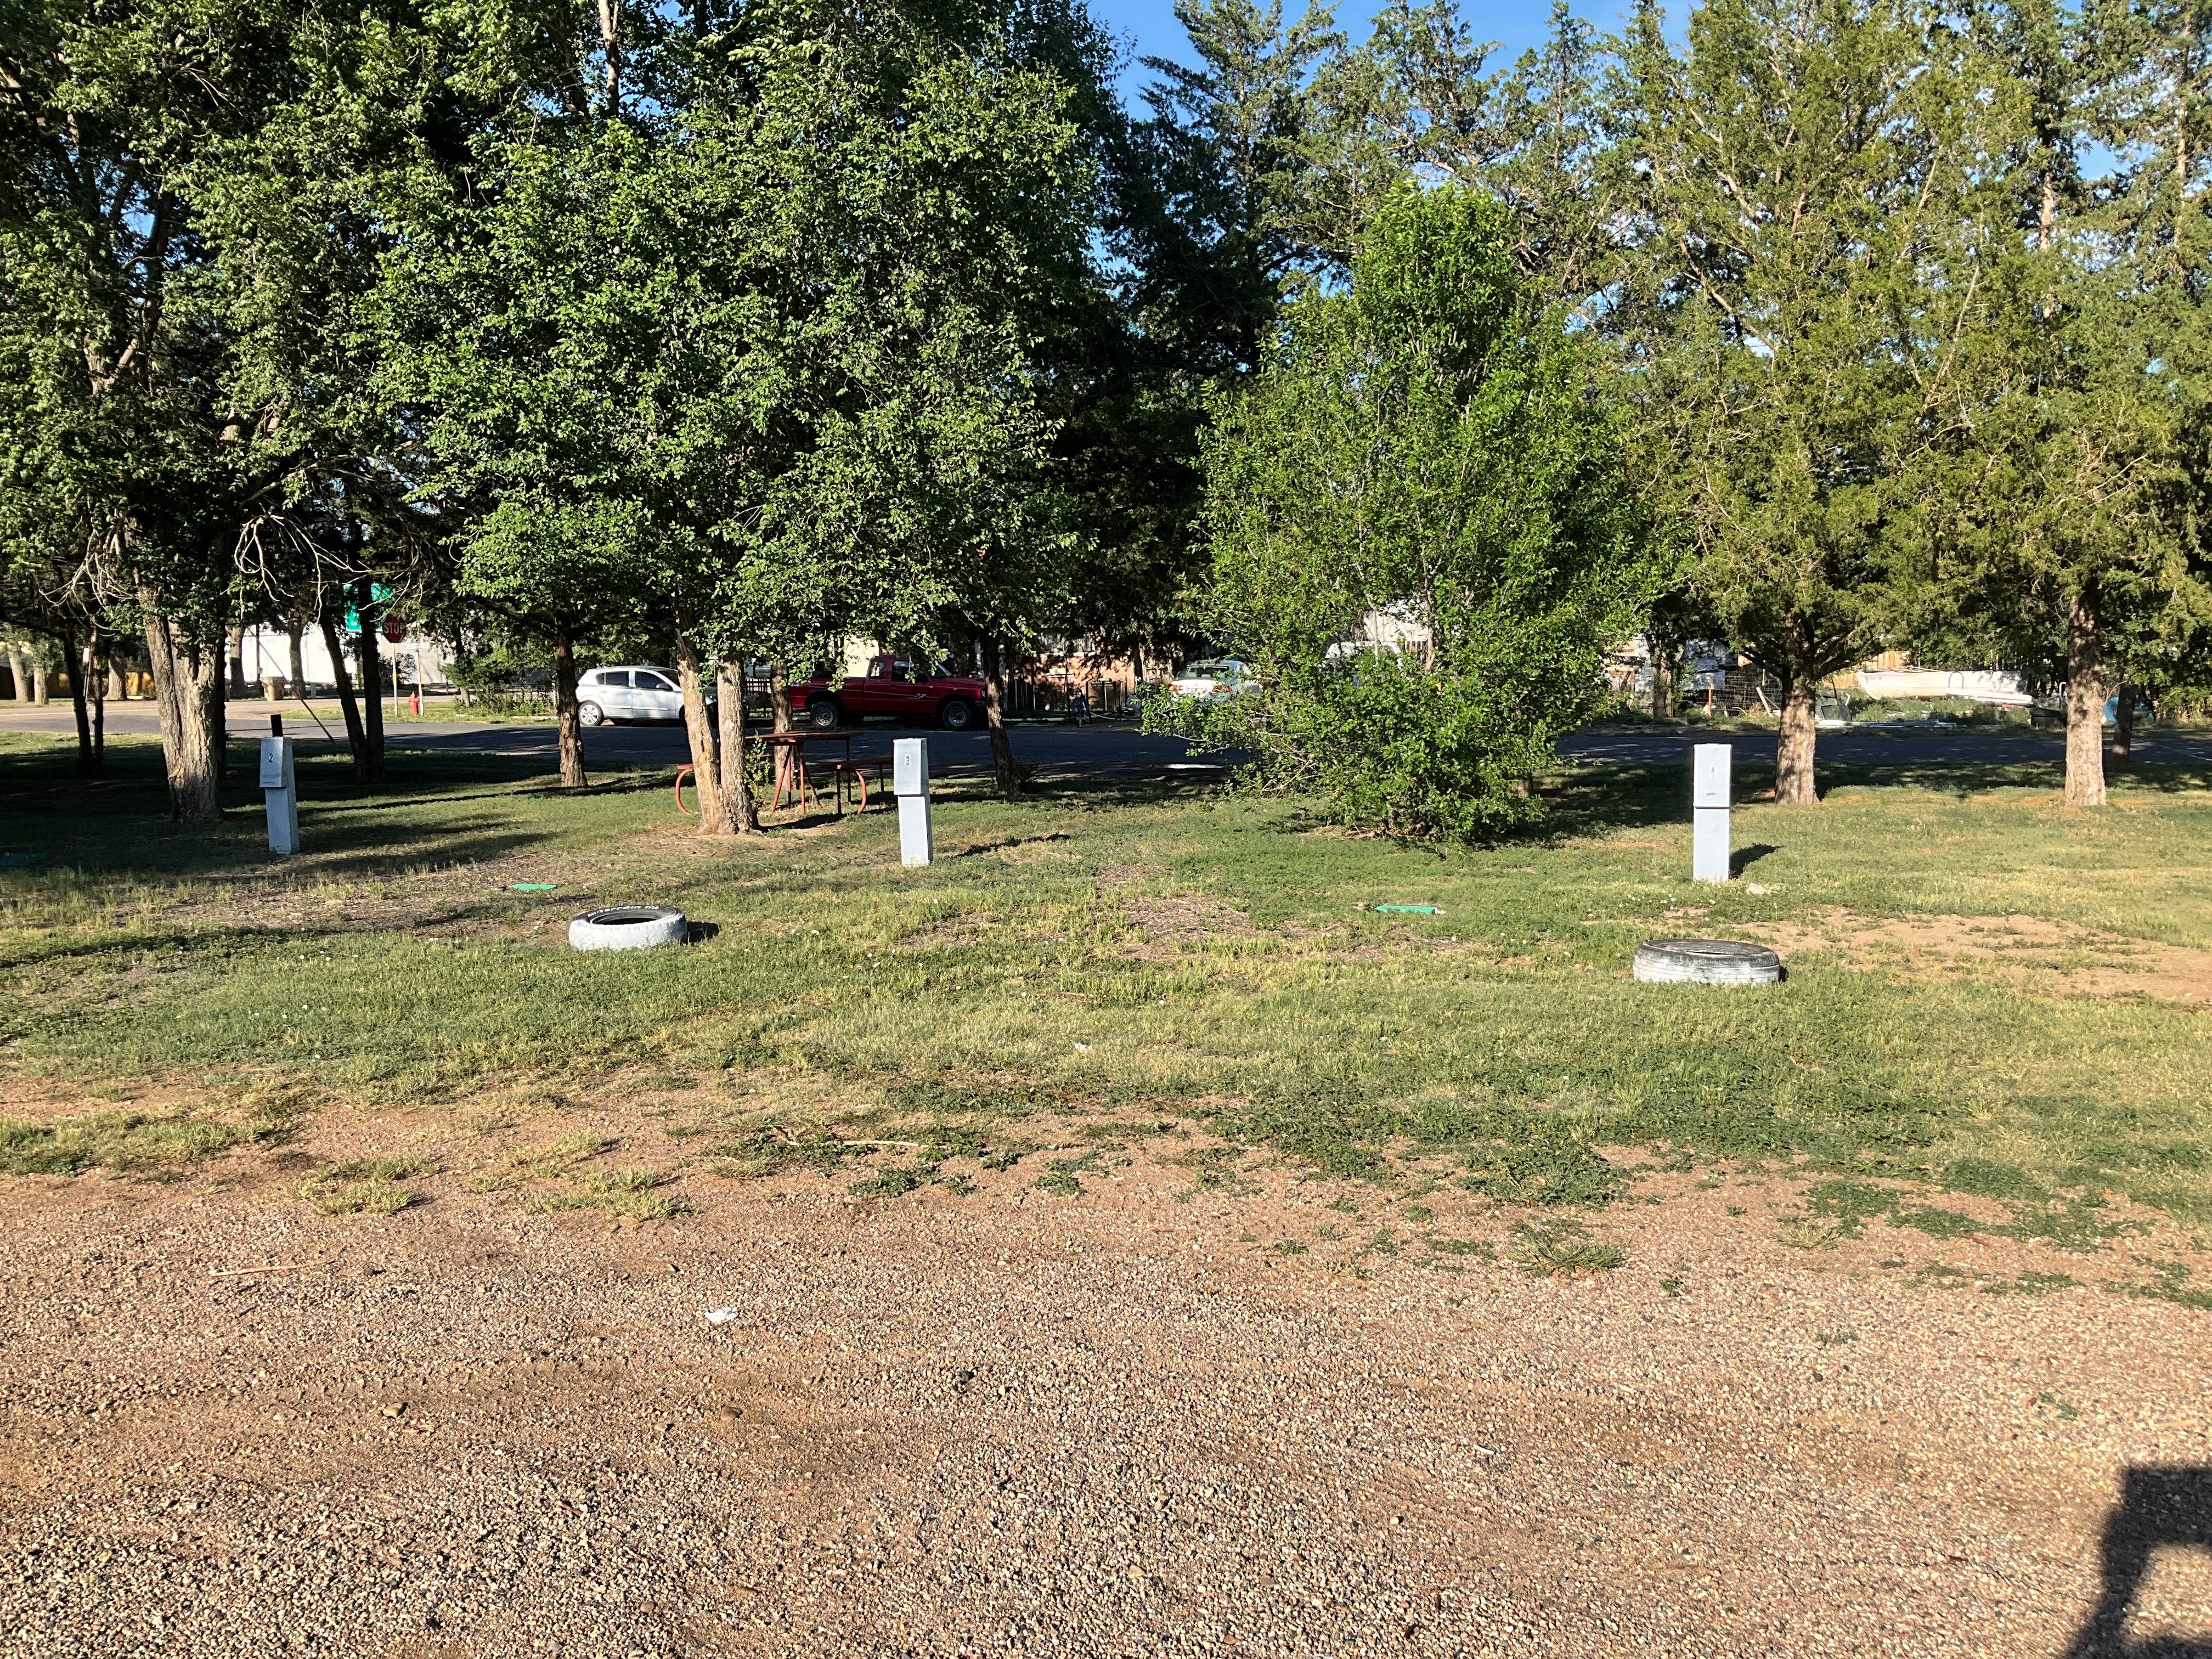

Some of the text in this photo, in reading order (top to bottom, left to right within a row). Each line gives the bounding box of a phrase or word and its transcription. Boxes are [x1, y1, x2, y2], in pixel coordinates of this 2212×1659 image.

[383, 622, 405, 634] STOP
[269, 753, 273, 763] 2
[906, 755, 910, 765] 3
